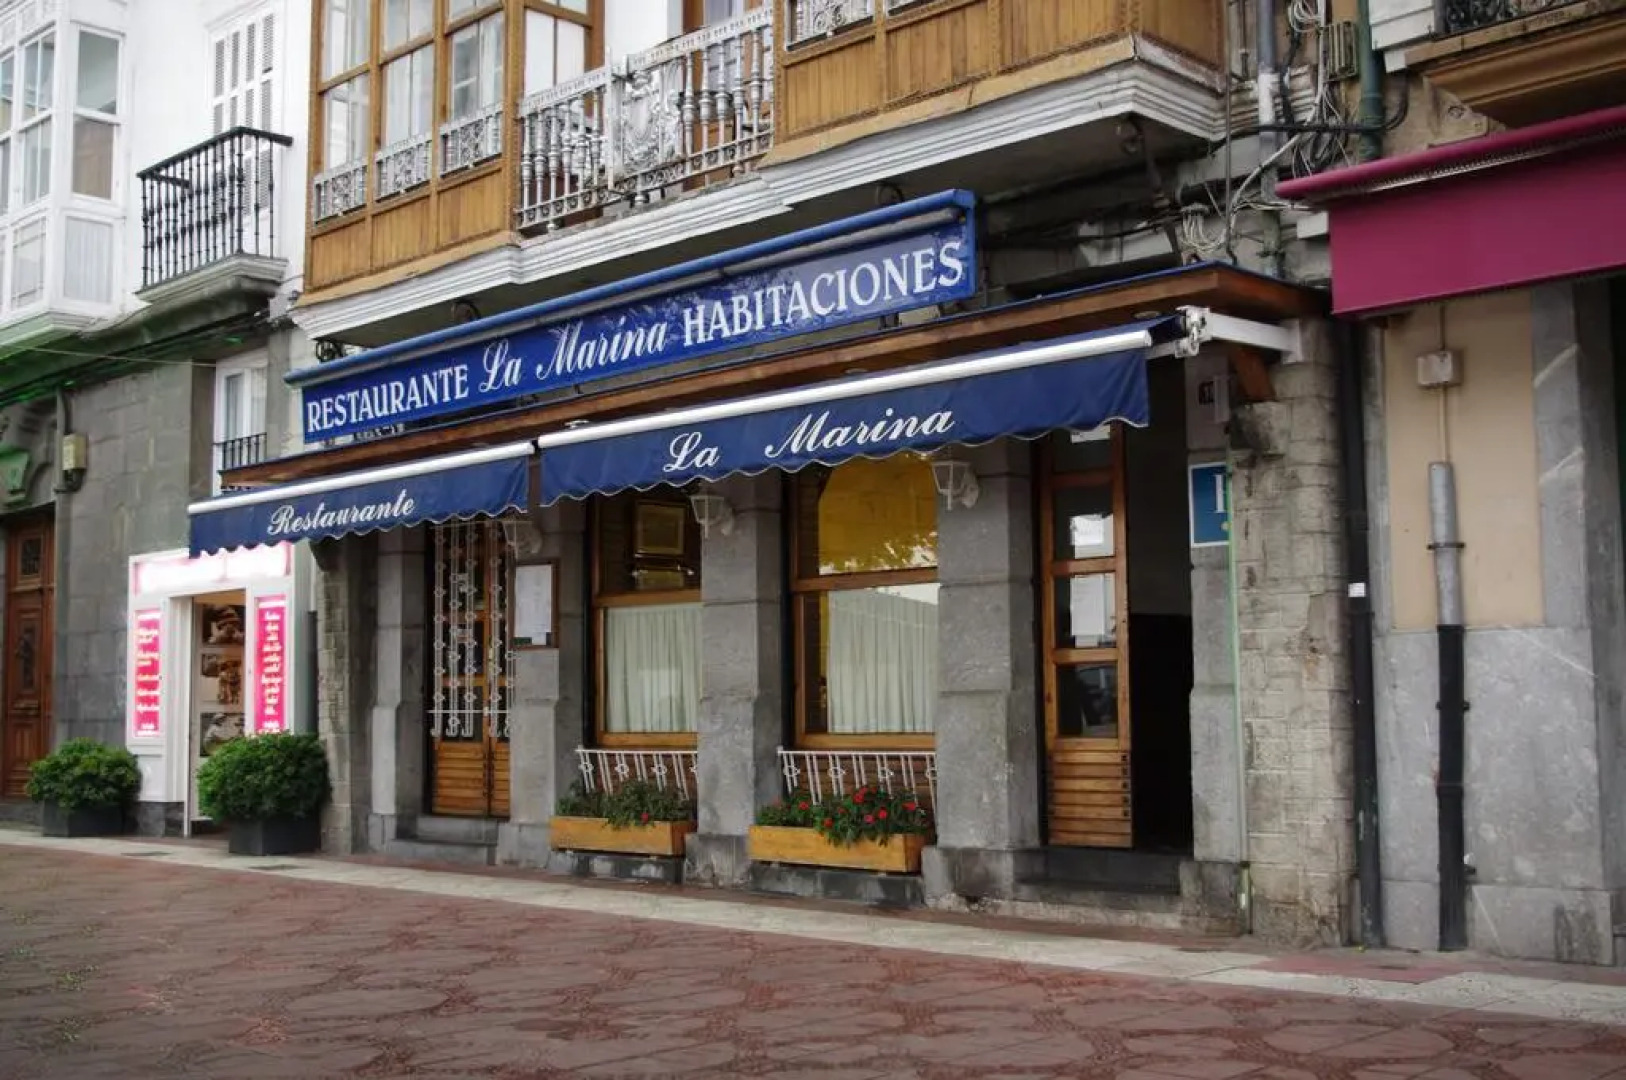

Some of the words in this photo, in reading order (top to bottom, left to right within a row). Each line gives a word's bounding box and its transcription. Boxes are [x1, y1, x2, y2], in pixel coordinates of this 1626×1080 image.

[306, 364, 470, 433] RESTAURANTE
[480, 341, 522, 393] La
[536, 318, 668, 379] Marina
[683, 242, 963, 346] HABITACIONES
[663, 431, 720, 472] La
[764, 408, 955, 458] Marina
[269, 489, 416, 535] Restaurante
